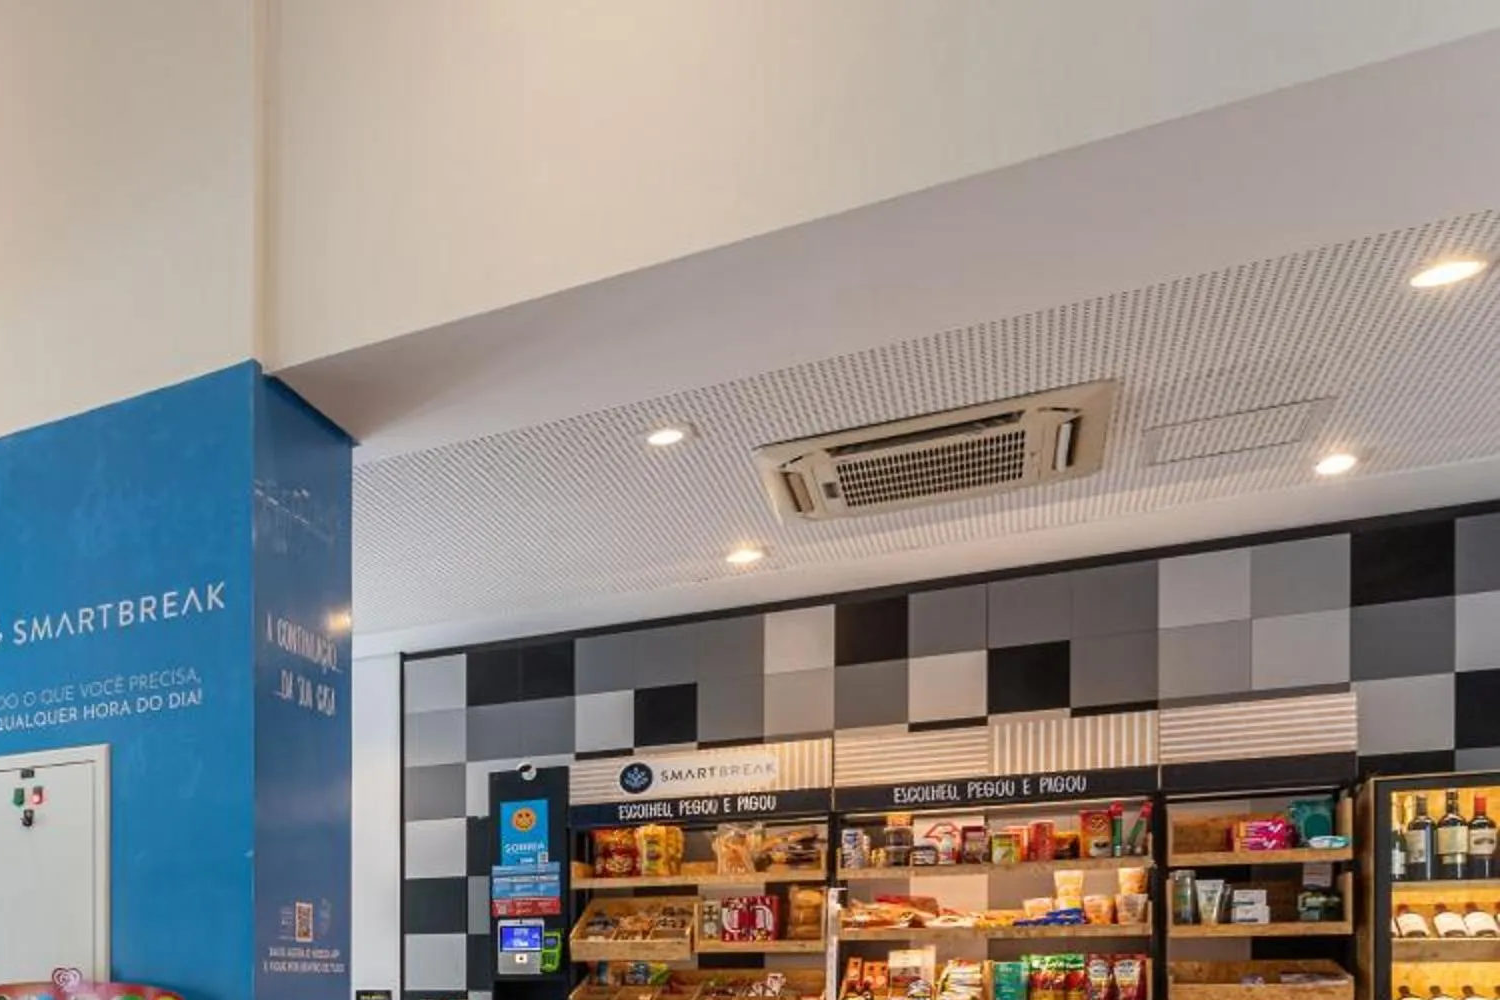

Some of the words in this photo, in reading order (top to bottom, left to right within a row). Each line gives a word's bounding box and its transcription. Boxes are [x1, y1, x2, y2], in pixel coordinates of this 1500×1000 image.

[13, 581, 225, 645] SMARTBREAK
[23, 691, 37, 707] O
[41, 685, 74, 705] QUE
[79, 674, 124, 699] VOCÊ
[83, 701, 131, 720] HORA
[136, 695, 163, 712] DO
[168, 688, 203, 710] DIA!
[661, 761, 776, 782] SMARTBREAK
[967, 781, 1015, 799] PEGOU
[1023, 778, 1032, 795] E
[1039, 775, 1087, 794] PAGOU
[679, 798, 718, 816] PEGOU
[723, 797, 731, 813] E
[737, 795, 777, 812] PAGOU
